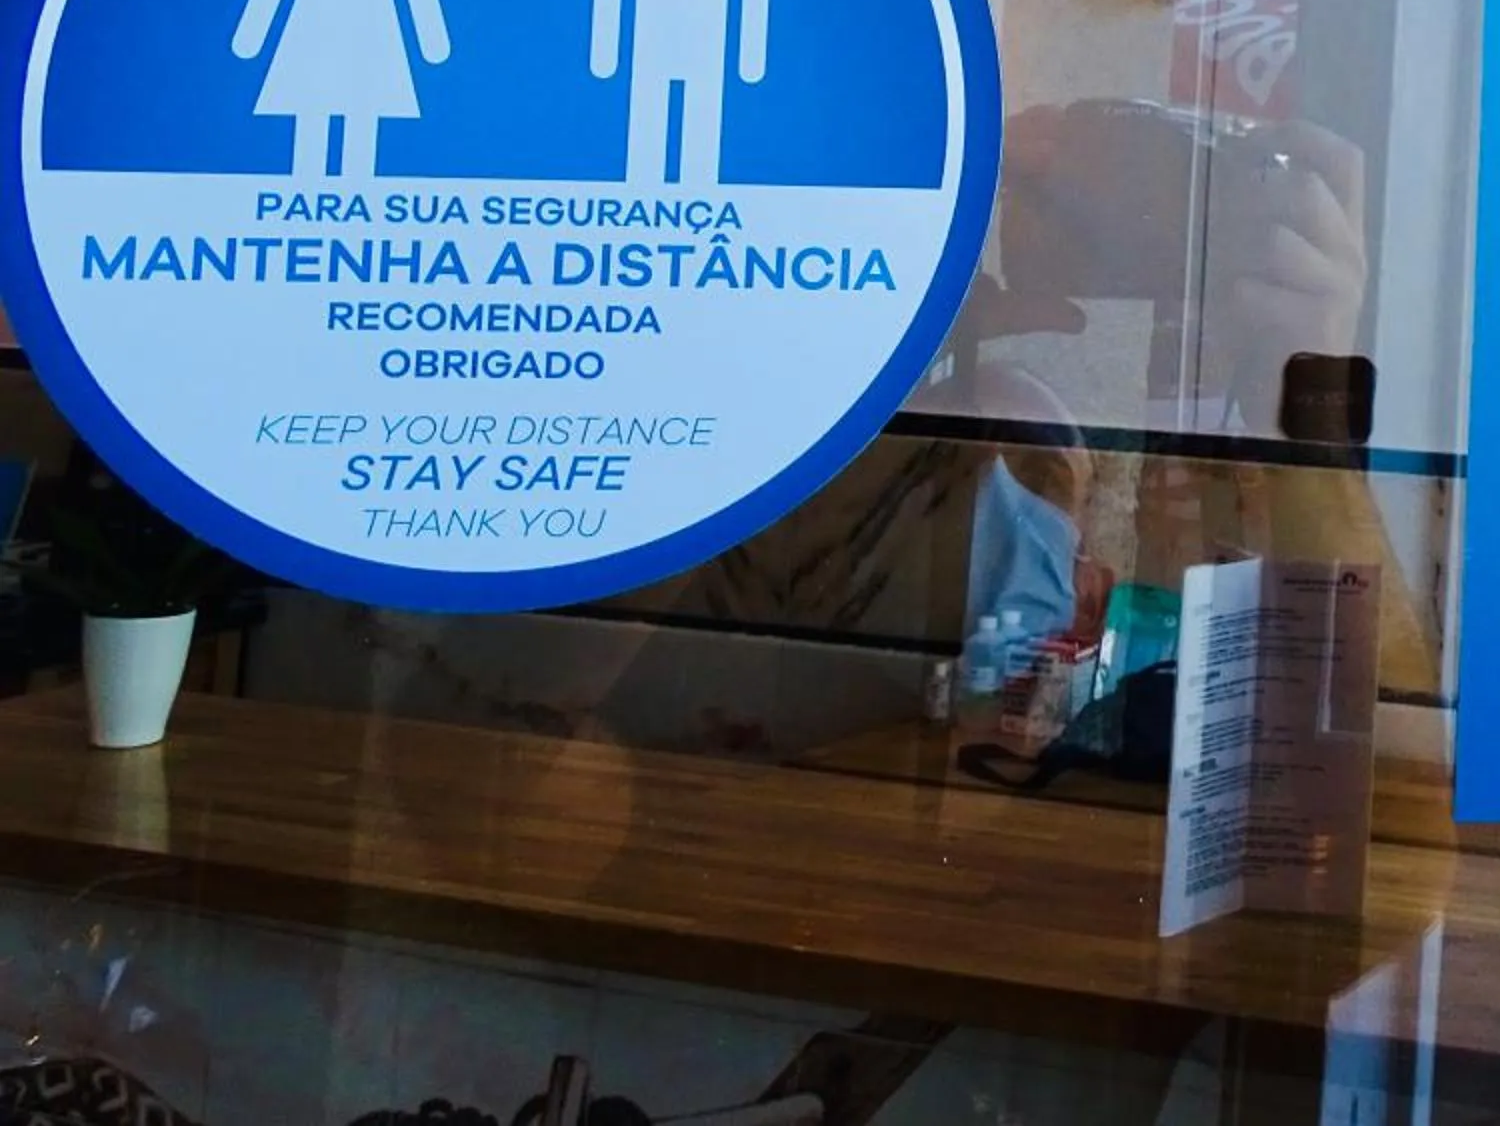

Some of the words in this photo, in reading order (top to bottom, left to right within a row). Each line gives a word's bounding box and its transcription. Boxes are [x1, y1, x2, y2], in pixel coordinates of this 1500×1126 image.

[256, 192, 372, 223] PARA
[384, 194, 469, 224] SUA
[482, 196, 742, 234] SEGURANÇA
[82, 235, 470, 285] MANTENHA
[485, 241, 532, 286] A
[552, 235, 896, 291] DISTÂNCIA
[327, 301, 661, 334] RECOMENDADA
[380, 348, 604, 380] OBRIGADO
[256, 415, 367, 444] KEEP
[382, 416, 496, 445] YOUR
[506, 416, 716, 446] DISTANCE
[341, 454, 486, 491] STAY
[494, 455, 631, 491] SAFE
[364, 509, 505, 537] THANK
[520, 509, 606, 538] YOU
